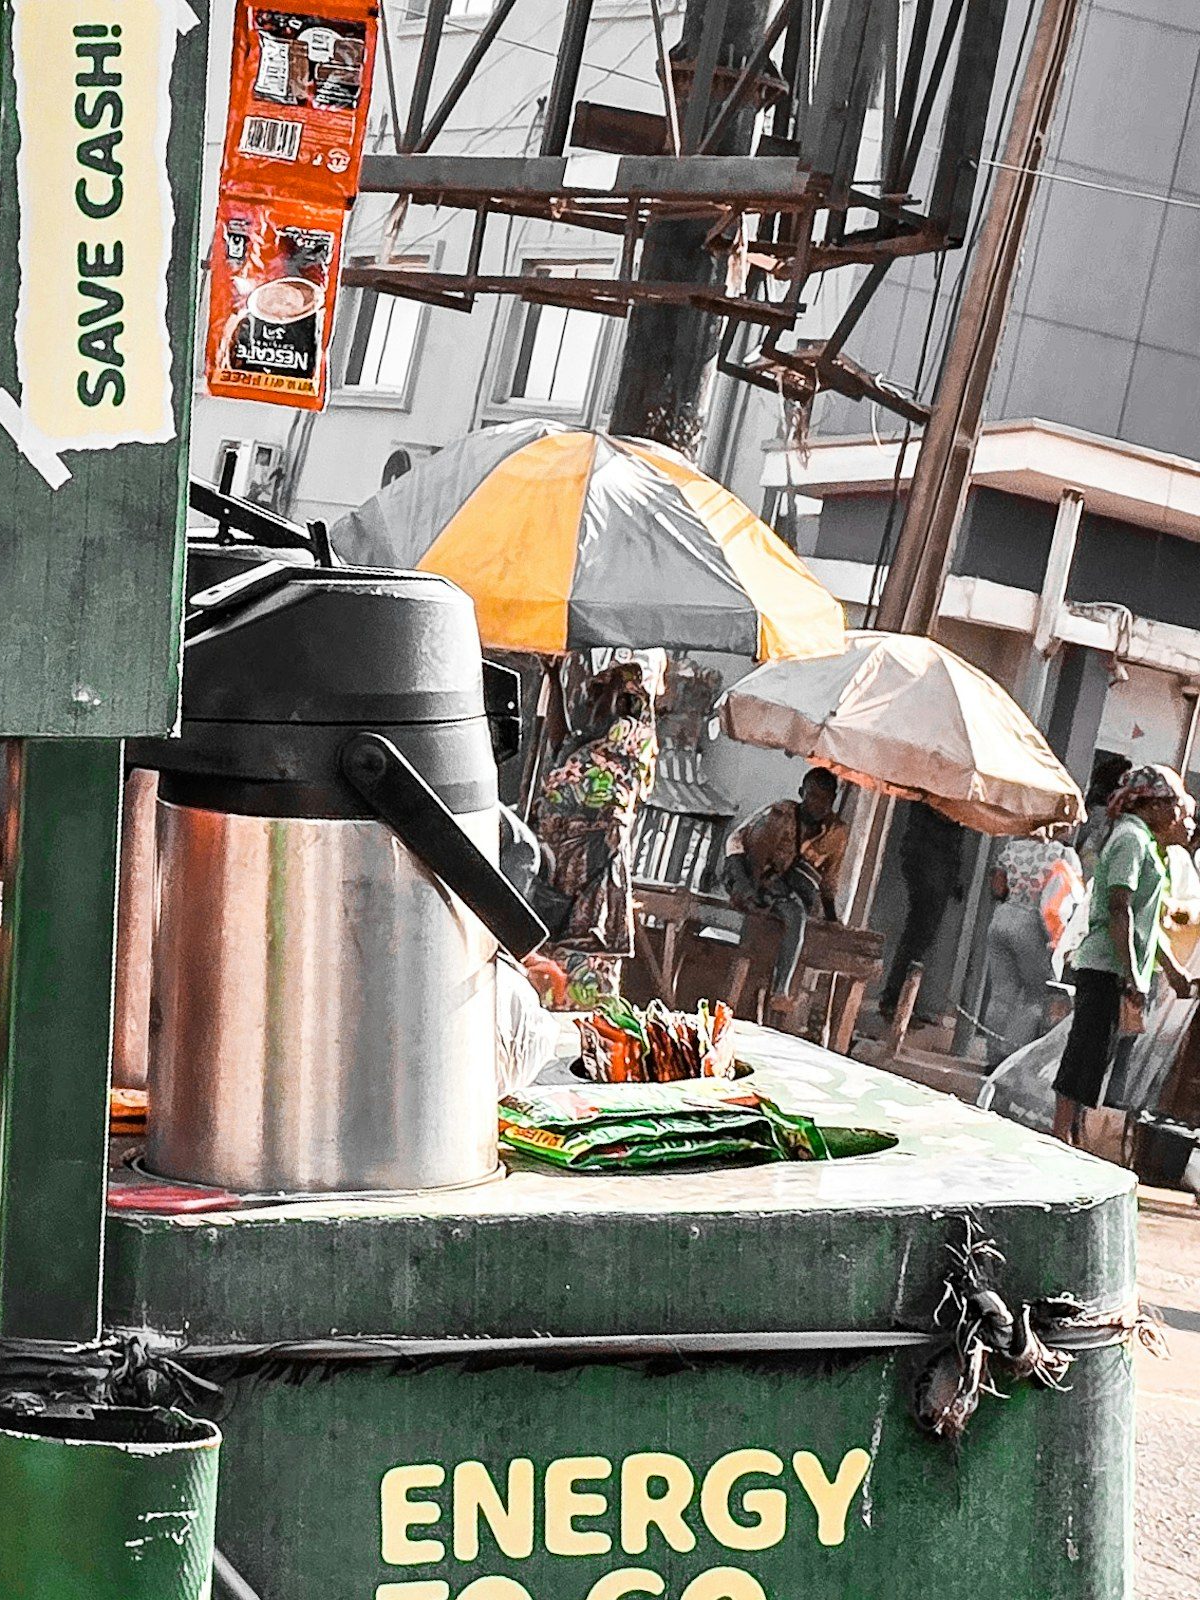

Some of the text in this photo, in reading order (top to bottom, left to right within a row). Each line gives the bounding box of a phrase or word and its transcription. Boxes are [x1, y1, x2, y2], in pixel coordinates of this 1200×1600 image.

[73, 23, 126, 407] SAVE CASH!
[220, 370, 262, 386] FREE
[381, 1447, 872, 1566] ENERGY
